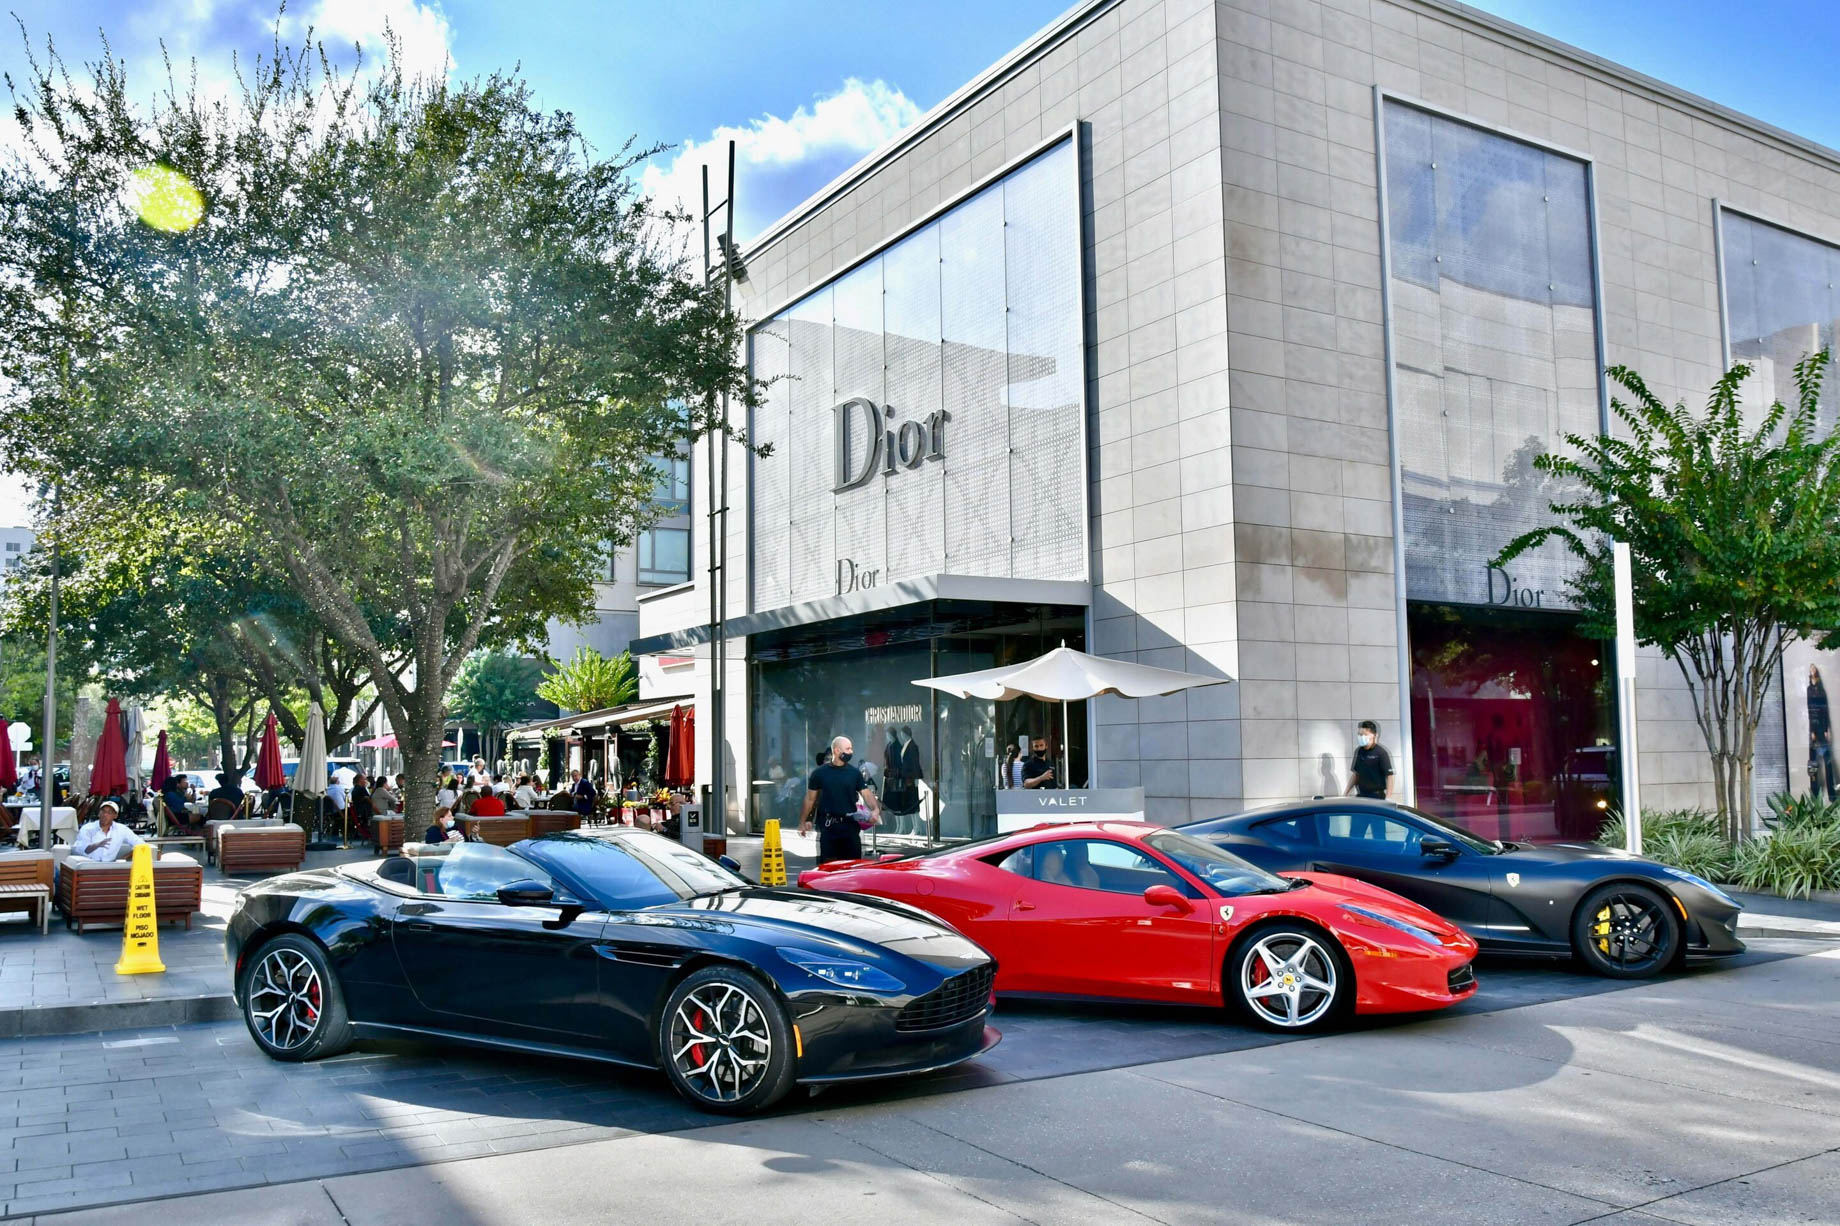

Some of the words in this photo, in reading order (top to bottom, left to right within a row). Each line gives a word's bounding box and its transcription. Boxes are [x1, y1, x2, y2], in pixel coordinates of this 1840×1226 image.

[829, 396, 951, 495] Dior
[837, 558, 880, 595] Dior
[1483, 565, 1545, 608] Dior
[1038, 796, 1087, 806] VALET
